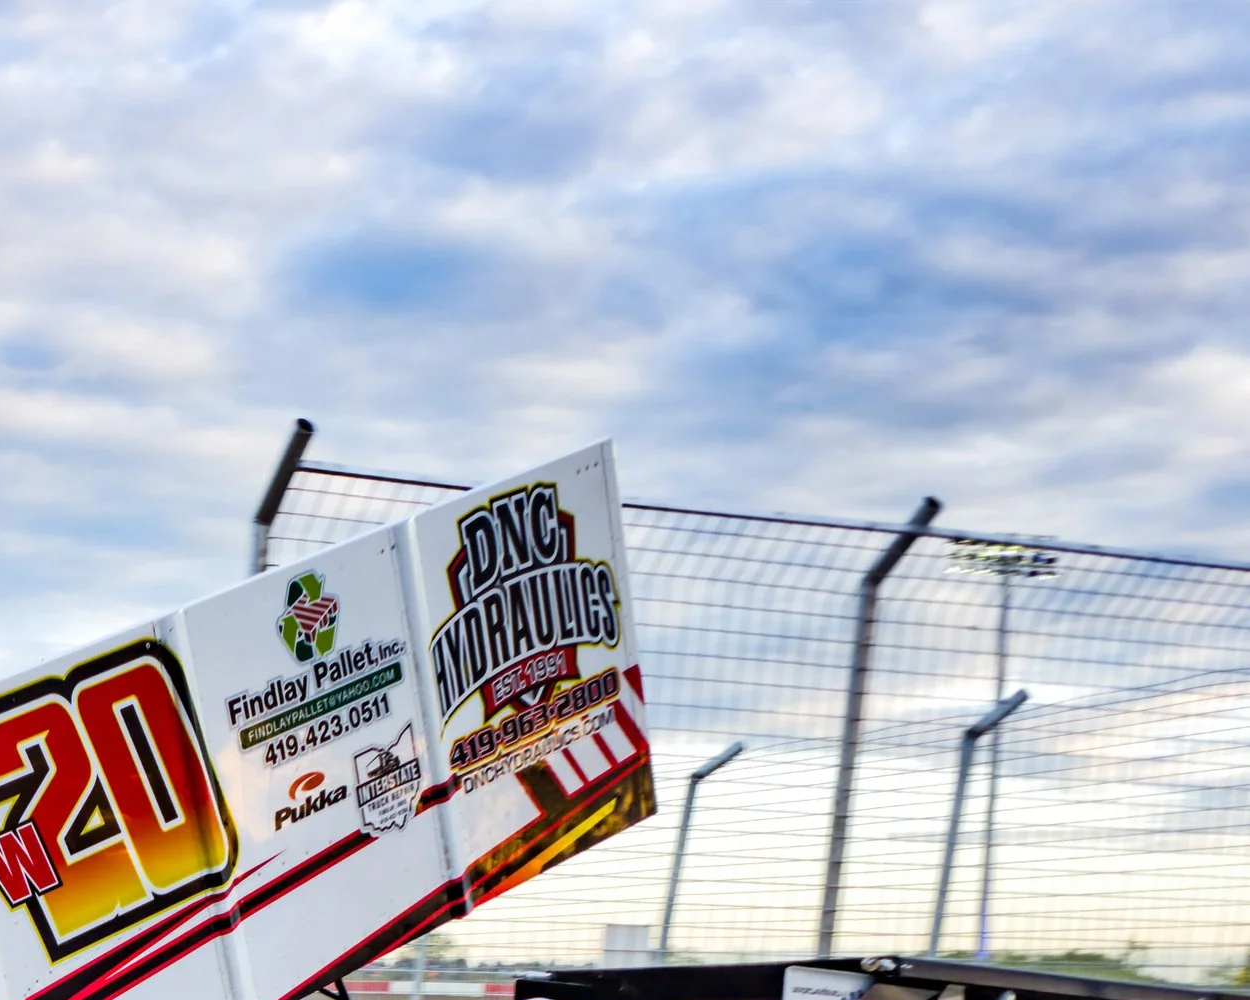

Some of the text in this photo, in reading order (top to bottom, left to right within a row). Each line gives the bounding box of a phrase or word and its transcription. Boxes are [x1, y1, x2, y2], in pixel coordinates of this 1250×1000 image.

[461, 486, 559, 597] DNC
[431, 560, 619, 712] HYDRAULICS
[228, 675, 308, 725] Findlay
[379, 641, 404, 660] Inc.
[248, 669, 396, 742] FINDLAYPALLET@YAHOO.COM
[492, 651, 568, 706] EST. 1991
[265, 693, 390, 765] 419.423.0511
[463, 707, 616, 794] DNCHYDRAULICS.COM
[275, 785, 348, 831] Pukka
[359, 761, 419, 805] INTERSTATE
